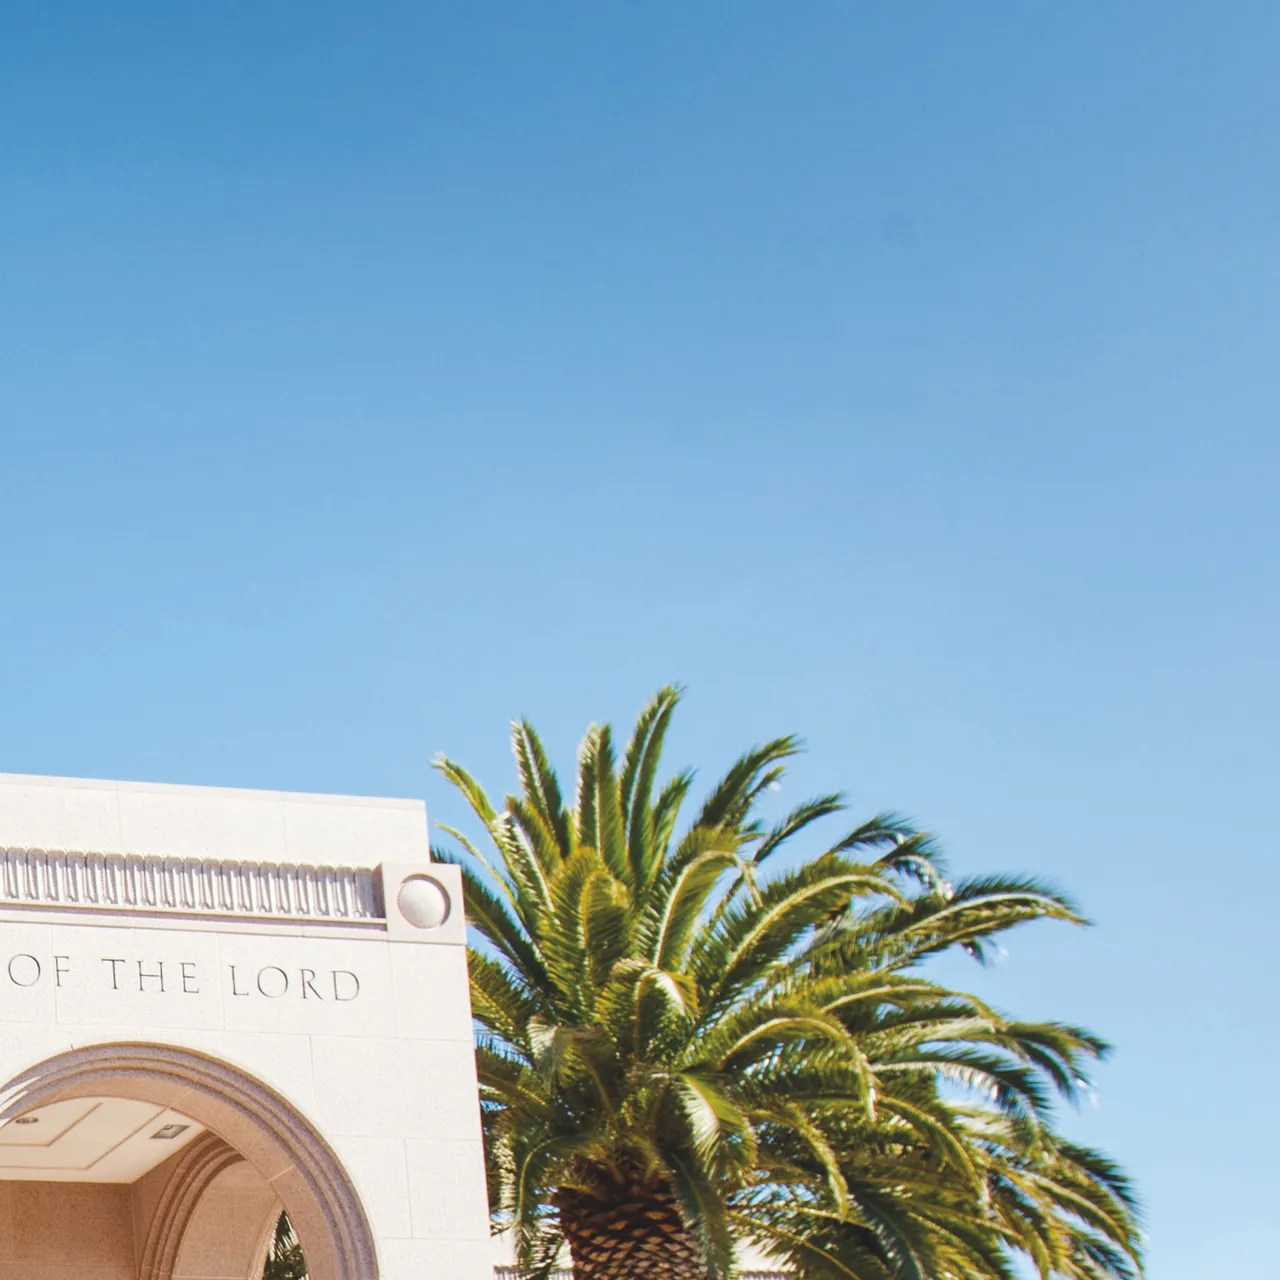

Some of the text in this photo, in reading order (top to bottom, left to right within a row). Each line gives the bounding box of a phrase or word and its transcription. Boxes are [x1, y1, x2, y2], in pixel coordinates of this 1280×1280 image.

[7, 953, 71, 988] OF
[100, 958, 201, 995] THE
[228, 964, 362, 1002] LORD
